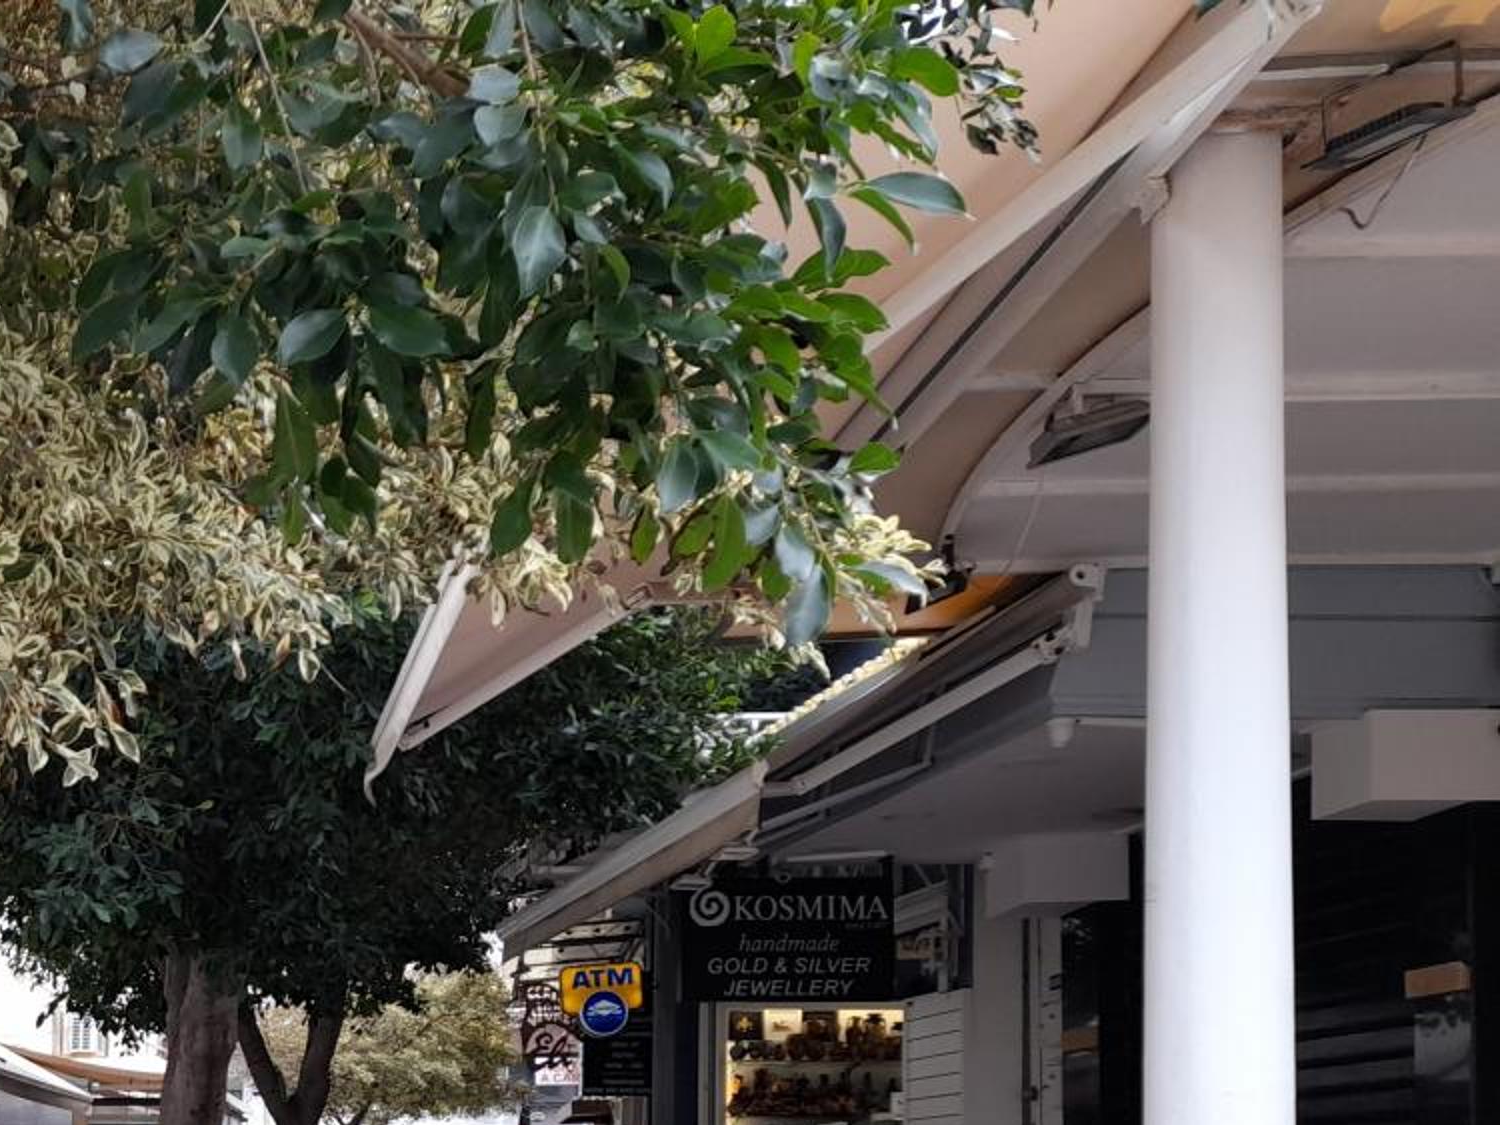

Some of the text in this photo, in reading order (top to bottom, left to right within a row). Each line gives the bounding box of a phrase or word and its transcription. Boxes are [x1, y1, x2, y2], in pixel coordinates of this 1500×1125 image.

[734, 895, 889, 921] KOSMIMA
[739, 932, 840, 952] handmade
[707, 957, 872, 975] GOLD & SILVER
[572, 967, 633, 989] ATM
[723, 978, 854, 997] JEWELLERY
